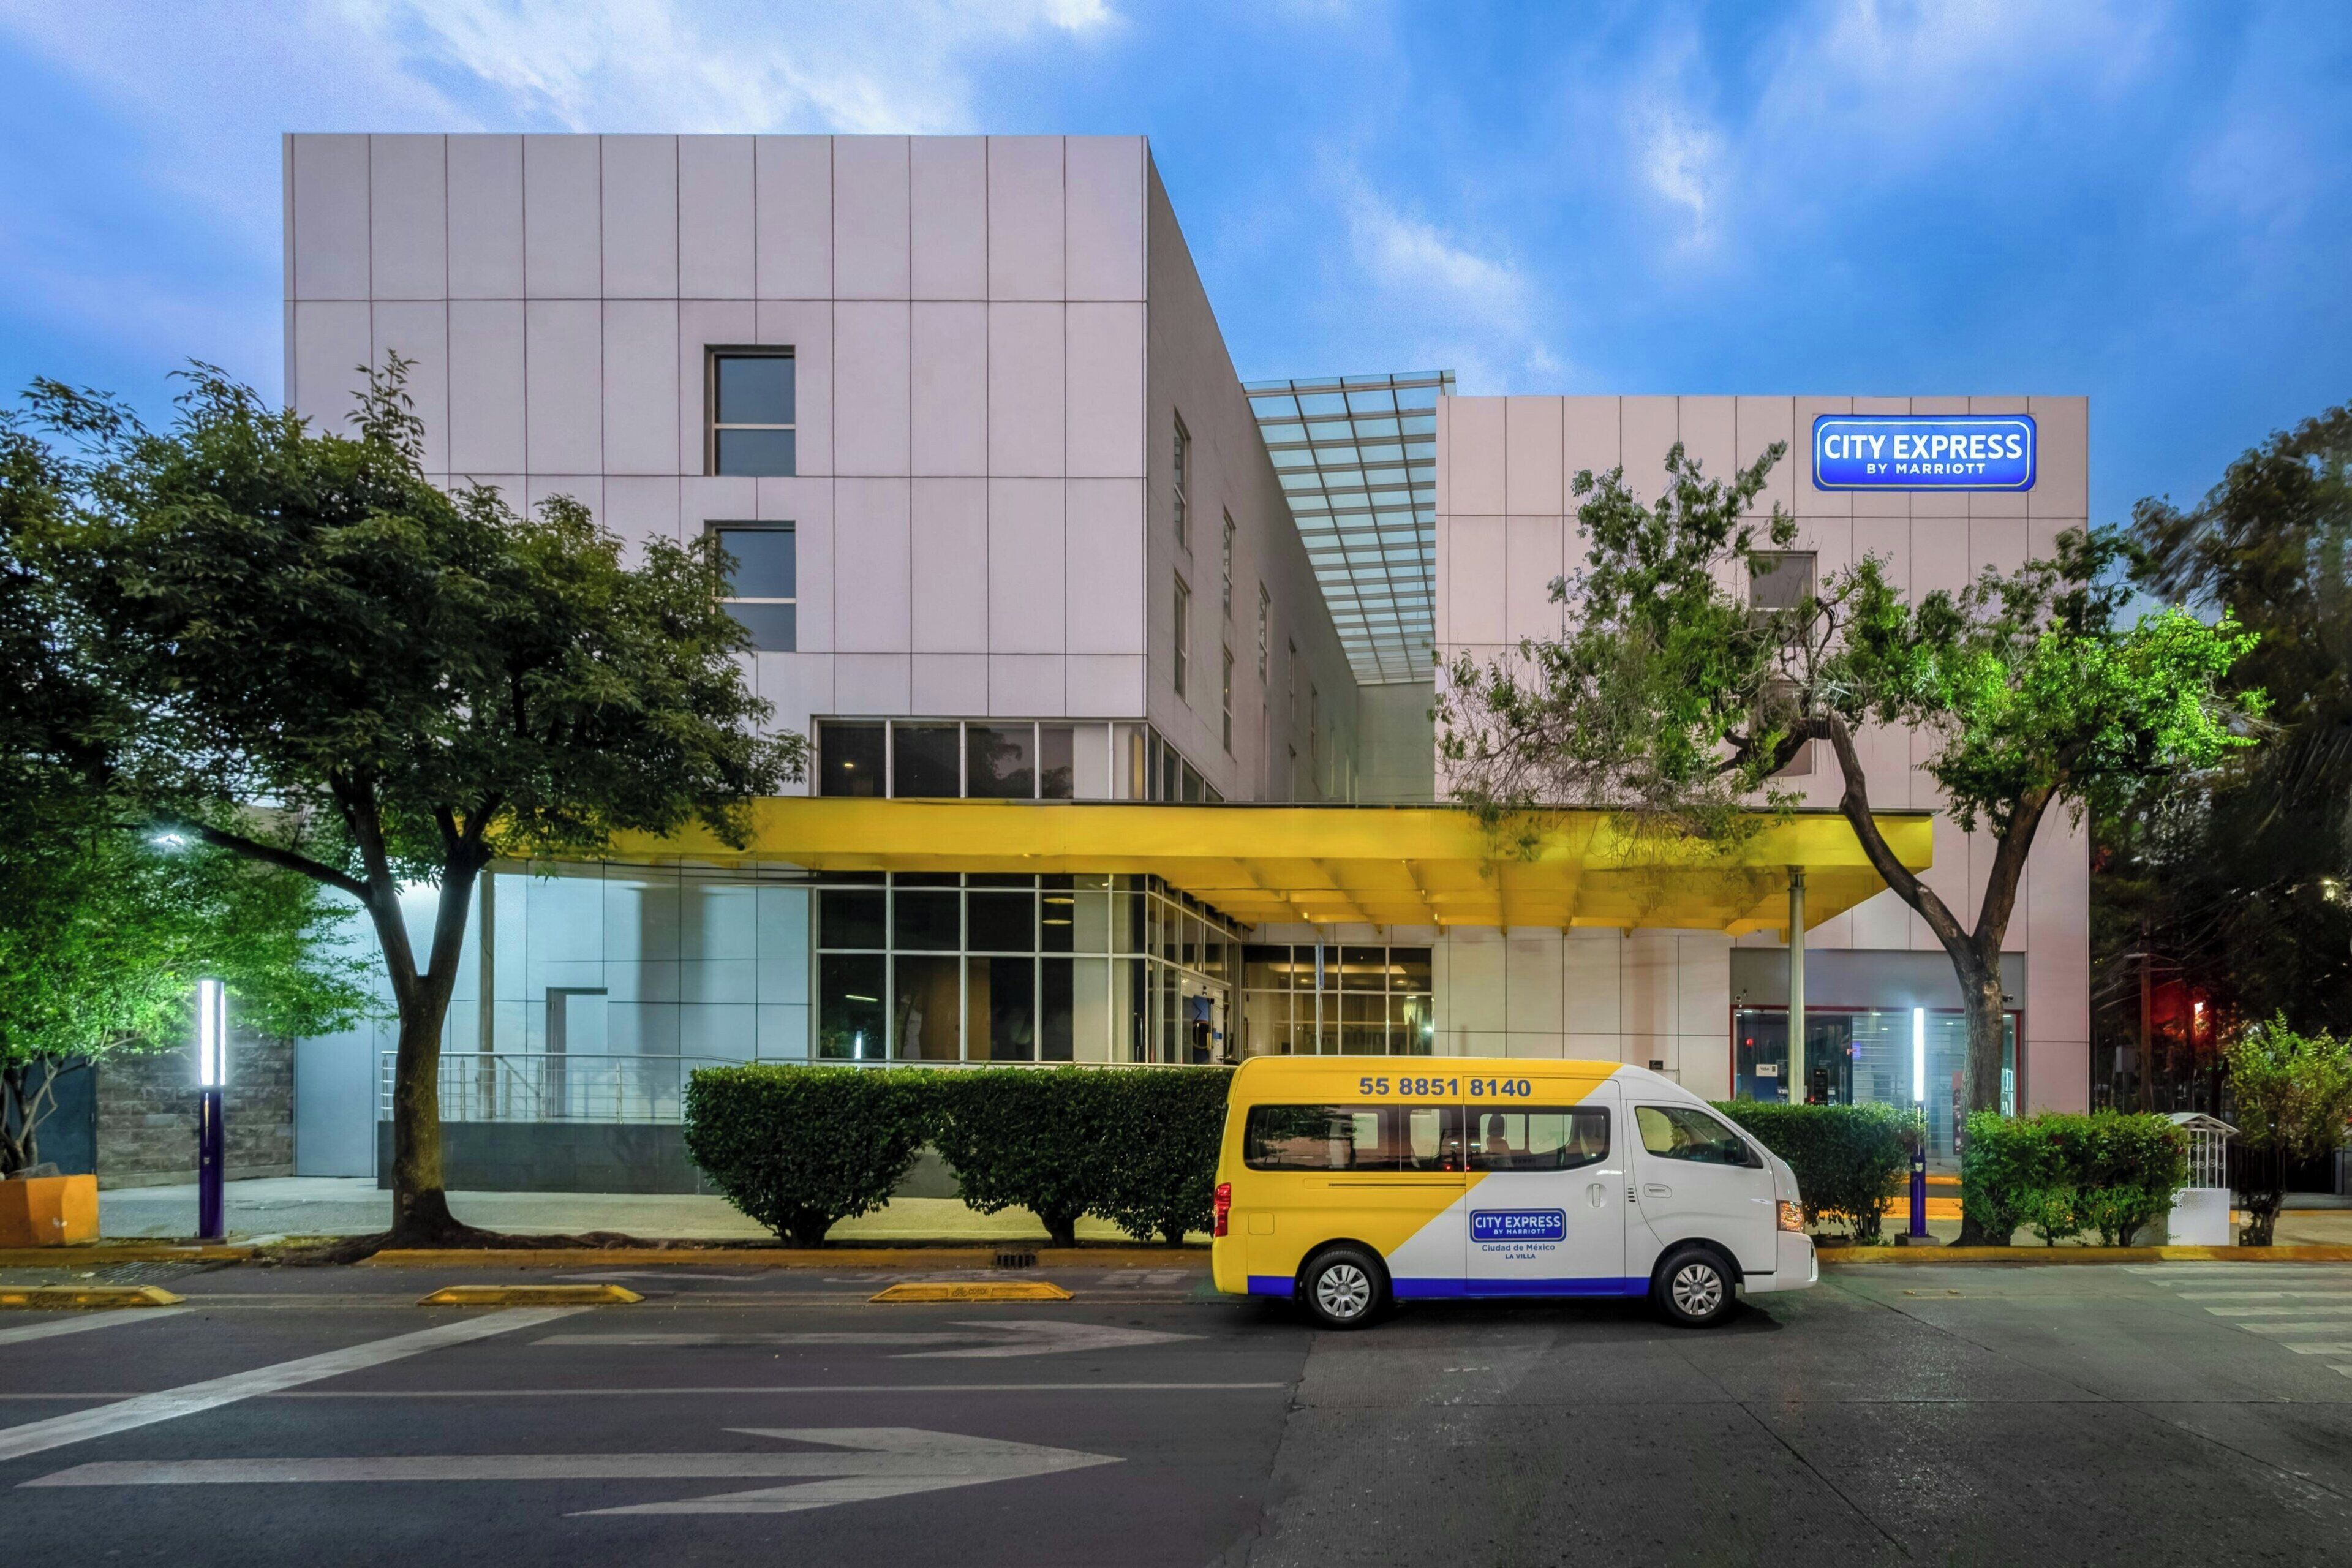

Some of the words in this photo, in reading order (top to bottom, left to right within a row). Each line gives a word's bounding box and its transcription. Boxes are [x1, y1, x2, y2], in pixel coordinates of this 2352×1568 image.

[1824, 434, 1887, 459] CITY
[1893, 434, 2022, 459] EXPRESS
[1866, 463, 1888, 474] BY
[1896, 463, 1986, 474] MARRIOTT
[1359, 1077, 1390, 1095] 55
[1399, 1077, 1458, 1096] 8851
[1470, 1079, 1531, 1097] 8140
[1475, 1217, 1502, 1228] CITY
[1506, 1216, 1561, 1227] EXPRESS
